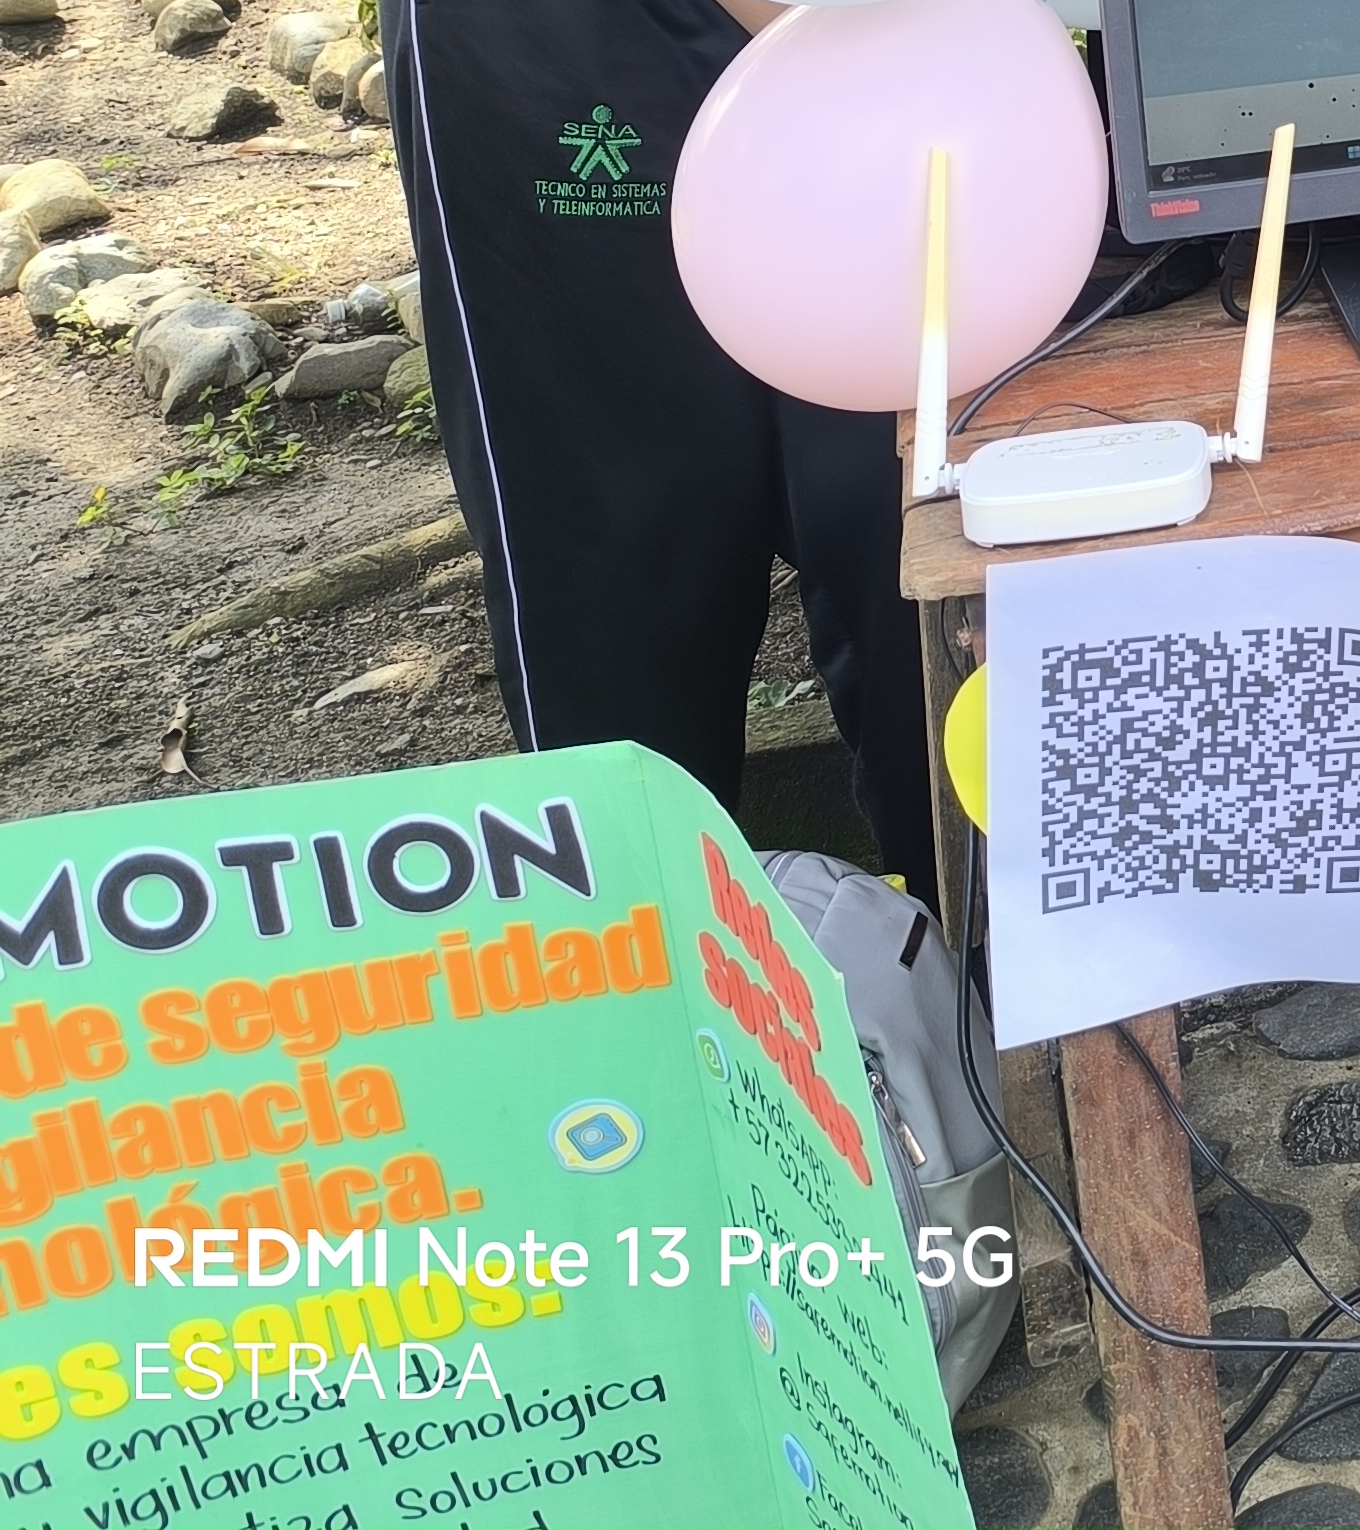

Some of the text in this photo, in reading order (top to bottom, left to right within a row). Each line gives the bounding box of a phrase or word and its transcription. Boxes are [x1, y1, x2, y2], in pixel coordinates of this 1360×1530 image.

[563, 122, 638, 139] SENA
[534, 181, 666, 198] TECNICO EN SISTEMAS
[538, 199, 660, 216] Y TELEINFORMATICA
[139, 904, 673, 1058] seguridad
[836, 1294, 889, 1370] web:
[84, 1373, 667, 1530] vigilancia tecnológica
[86, 1381, 347, 1470] empresa
[396, 1353, 463, 1393] de
[796, 1351, 902, 1490] Instagram:
